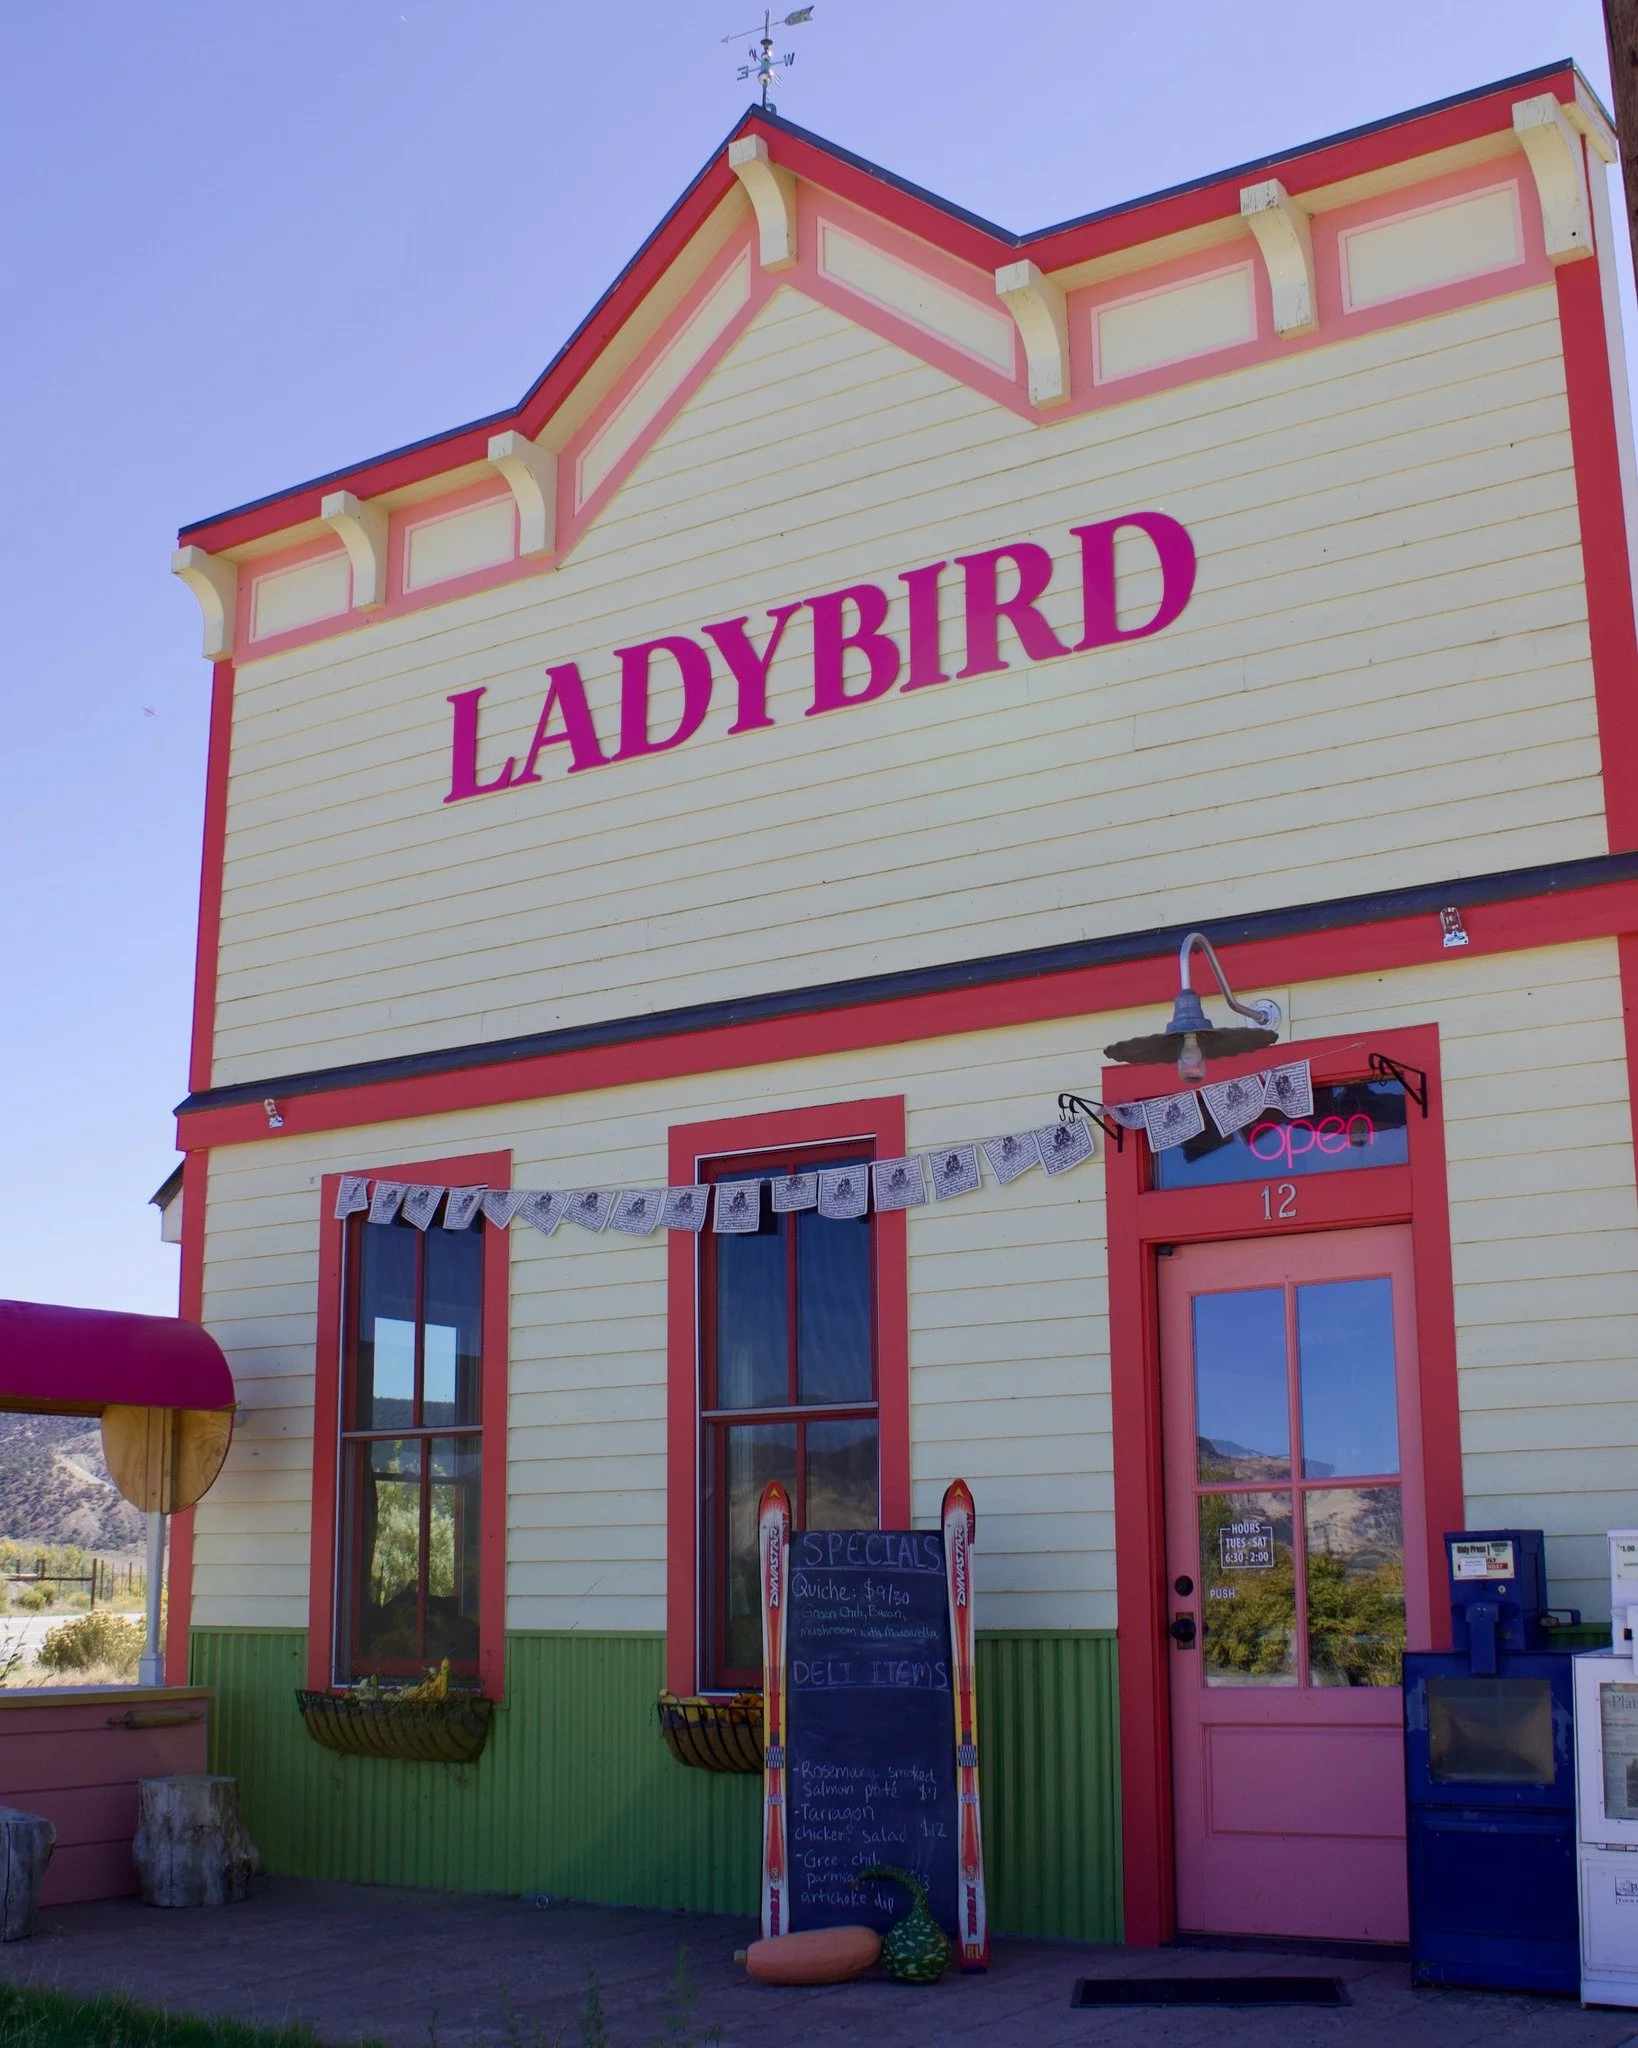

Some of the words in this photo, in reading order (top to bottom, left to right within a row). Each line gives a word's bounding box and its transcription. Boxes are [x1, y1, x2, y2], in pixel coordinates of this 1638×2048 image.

[443, 511, 1197, 804] LADYBIRD
[1250, 1113, 1374, 1169] open
[1260, 1183, 1298, 1220] 12
[1225, 1538, 1246, 1549] TUES
[1252, 1537, 1267, 1548] SAT
[1231, 1523, 1260, 1534] HOURS
[803, 1531, 941, 1570] SPECIALS
[955, 1525, 966, 1608] DYNASTAR
[1225, 1552, 1244, 1563] 6:30
[1250, 1552, 1269, 1563] 2:00
[769, 1526, 780, 1609] DYNASTAR
[1210, 1588, 1236, 1599] PUSH
[793, 1660, 856, 1686] DELI
[872, 1660, 949, 1688] ITEMS
[874, 1893, 895, 1914] dip
